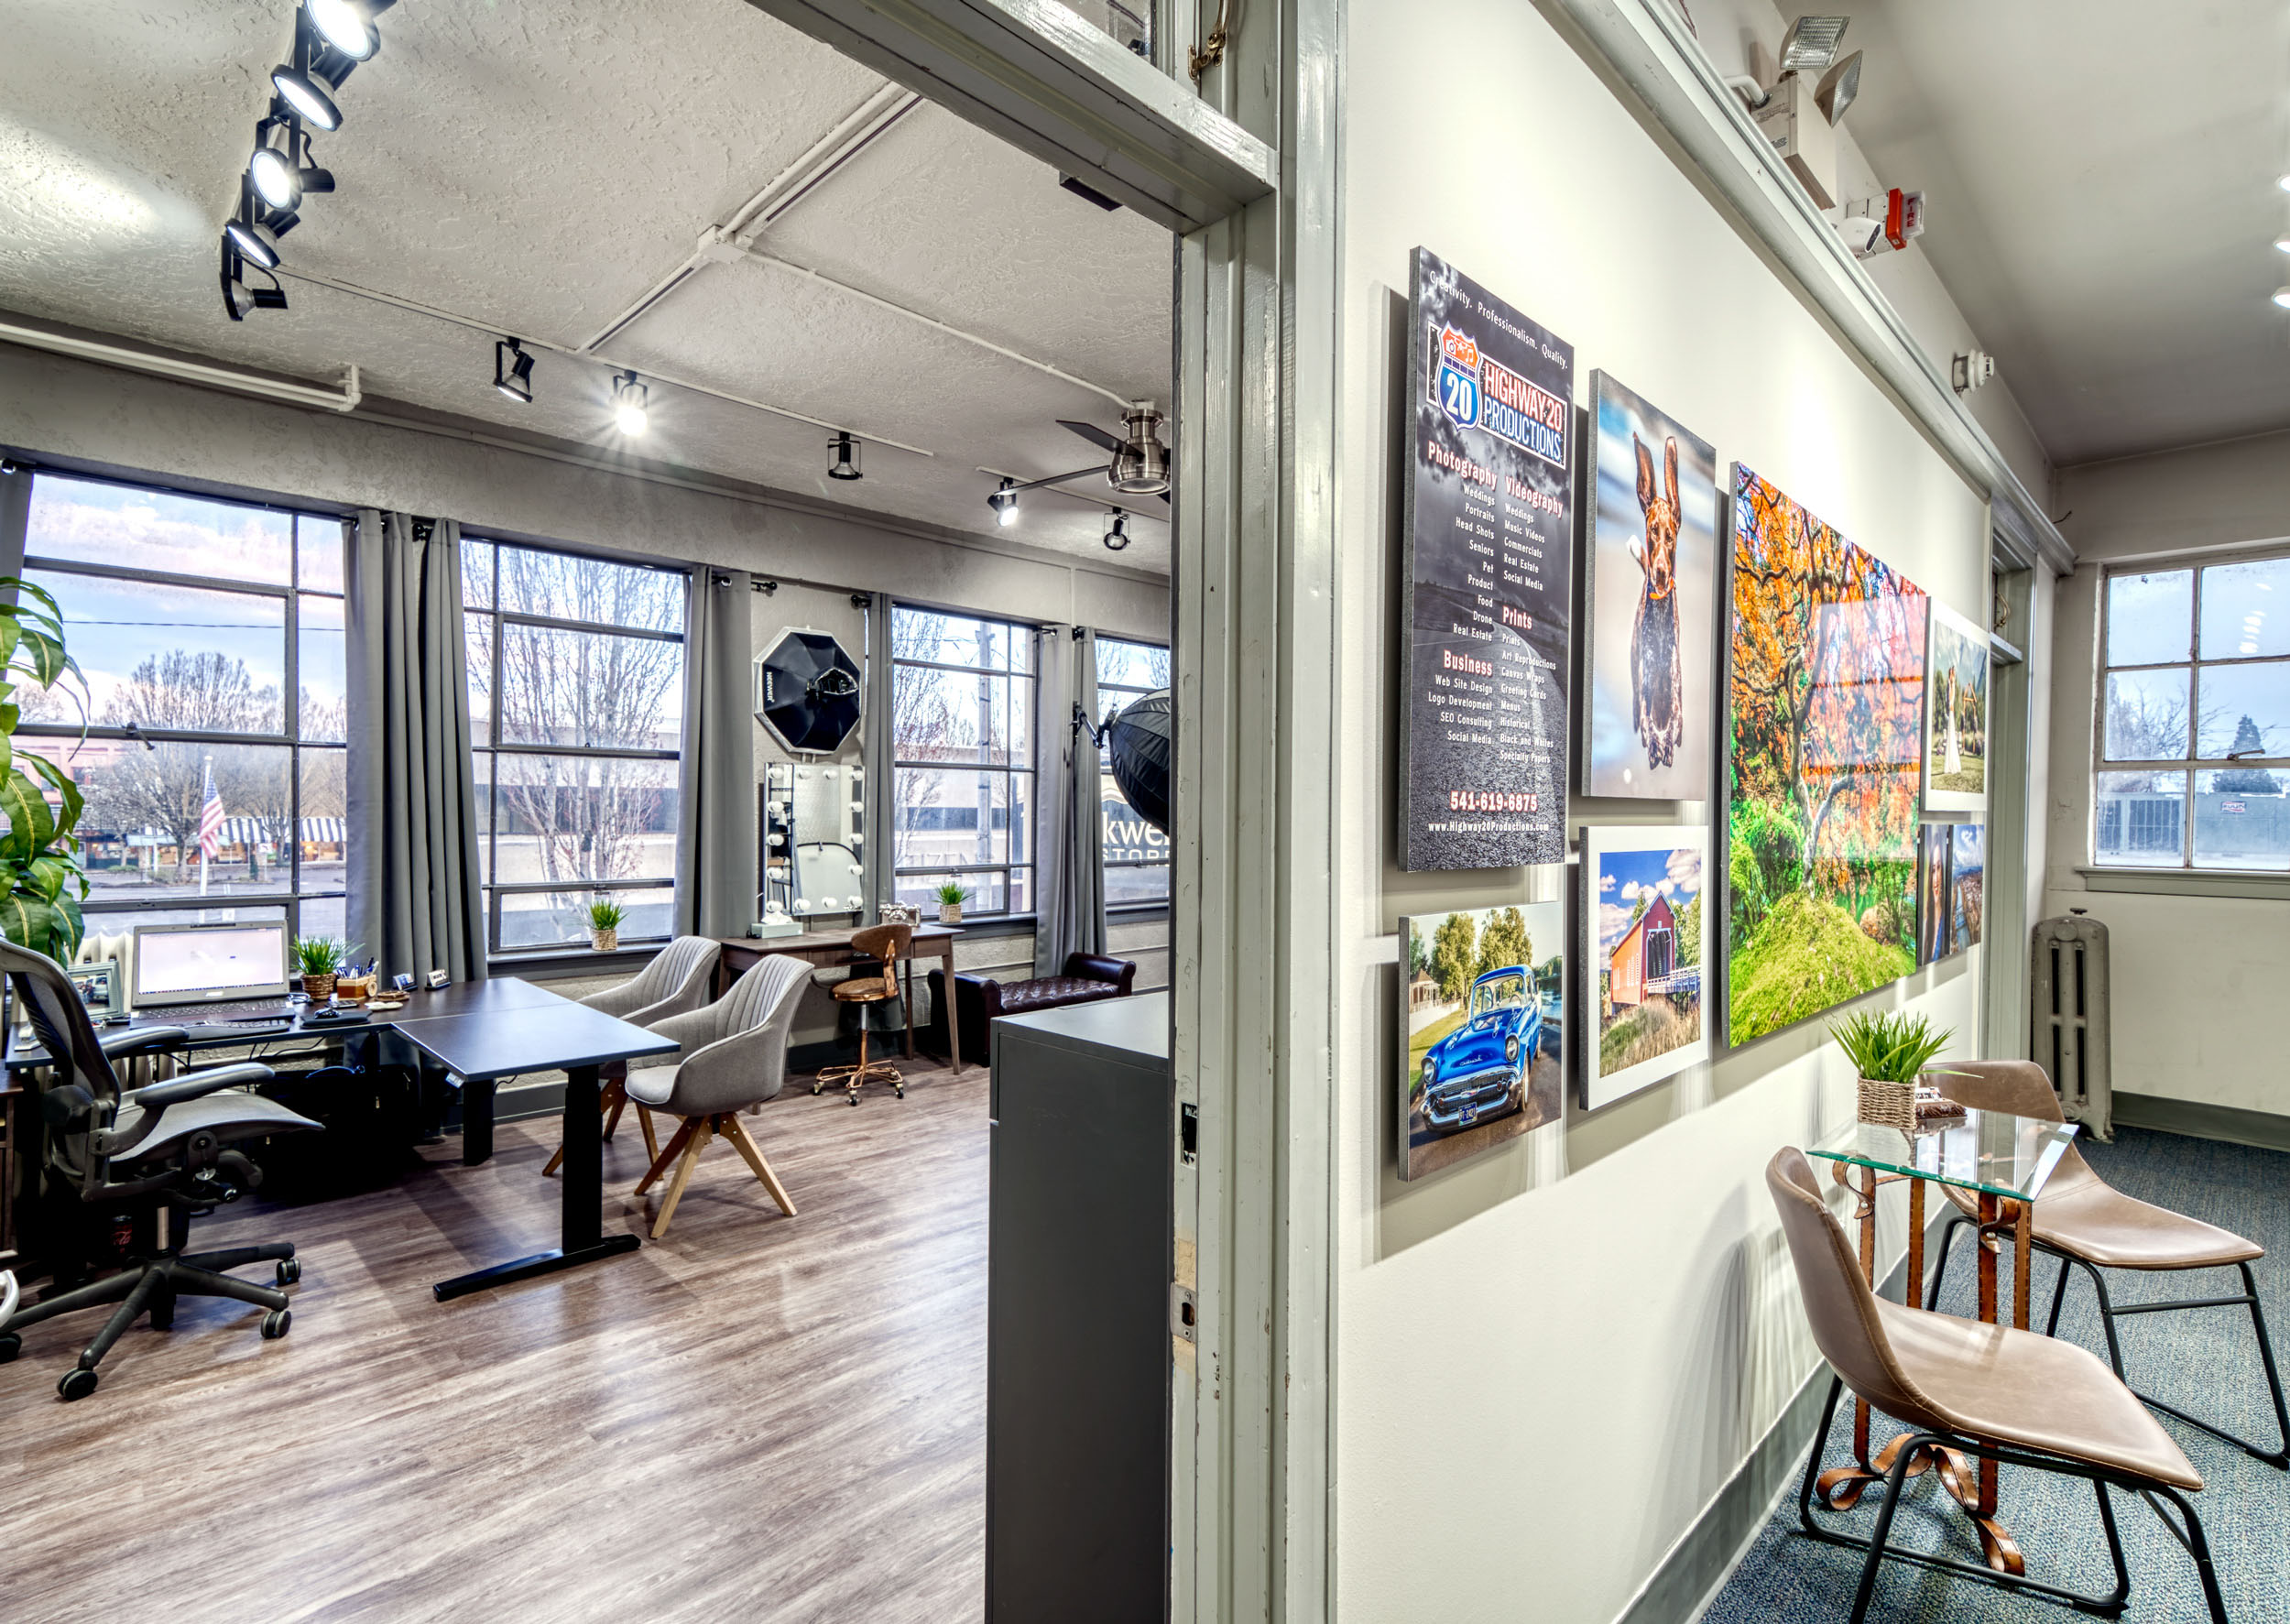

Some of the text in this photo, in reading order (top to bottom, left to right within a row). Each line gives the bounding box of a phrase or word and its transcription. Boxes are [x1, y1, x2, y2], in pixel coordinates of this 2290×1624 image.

[1907, 197, 1915, 227] FIRE
[1430, 270, 1567, 369] Creativity. Professionalism. Quality.
[1446, 372, 1472, 420] 20
[1485, 361, 1563, 432] HIGHWAY 20
[1484, 394, 1561, 461] PRODUCTIONS
[1428, 440, 1497, 491] Photography
[1464, 485, 1495, 507] Weddings
[1506, 476, 1564, 519] Videography
[1466, 503, 1495, 522] Portraits
[1505, 504, 1534, 524] Weddings
[1456, 518, 1494, 540] Head Shots
[1505, 520, 1545, 543] Music Videos
[1469, 540, 1494, 556] Seniors
[1504, 537, 1543, 559] Commercials
[1483, 561, 1494, 573] Pet
[1504, 553, 1539, 573] Real Estate
[1468, 574, 1493, 590] Product
[1504, 571, 1543, 591] Social Media
[1478, 594, 1493, 608] Food
[1473, 611, 1492, 625] Drone
[1502, 605, 1532, 629] Prints
[1454, 624, 1492, 642] Real Estate
[1502, 634, 1521, 647] Prints
[1444, 649, 1492, 676] Business
[1502, 650, 1556, 670] Art Reproductions
[1435, 675, 1492, 694] Web Site Design
[1502, 667, 1544, 684] Canvas Wraps
[1501, 683, 1546, 700] Greeting Cards
[1428, 692, 1492, 711] Logo Development
[1501, 700, 1521, 713] Menus
[1440, 713, 1492, 728] SEO Consulting
[1500, 717, 1530, 729] Historical
[1447, 731, 1492, 745] Social Media
[1500, 733, 1554, 747] Black and Whites
[1500, 750, 1550, 764] Specialty Papers
[1450, 790, 1538, 812] 541-619-6875
[1428, 822, 1549, 833] www.Highway20Productions.com
